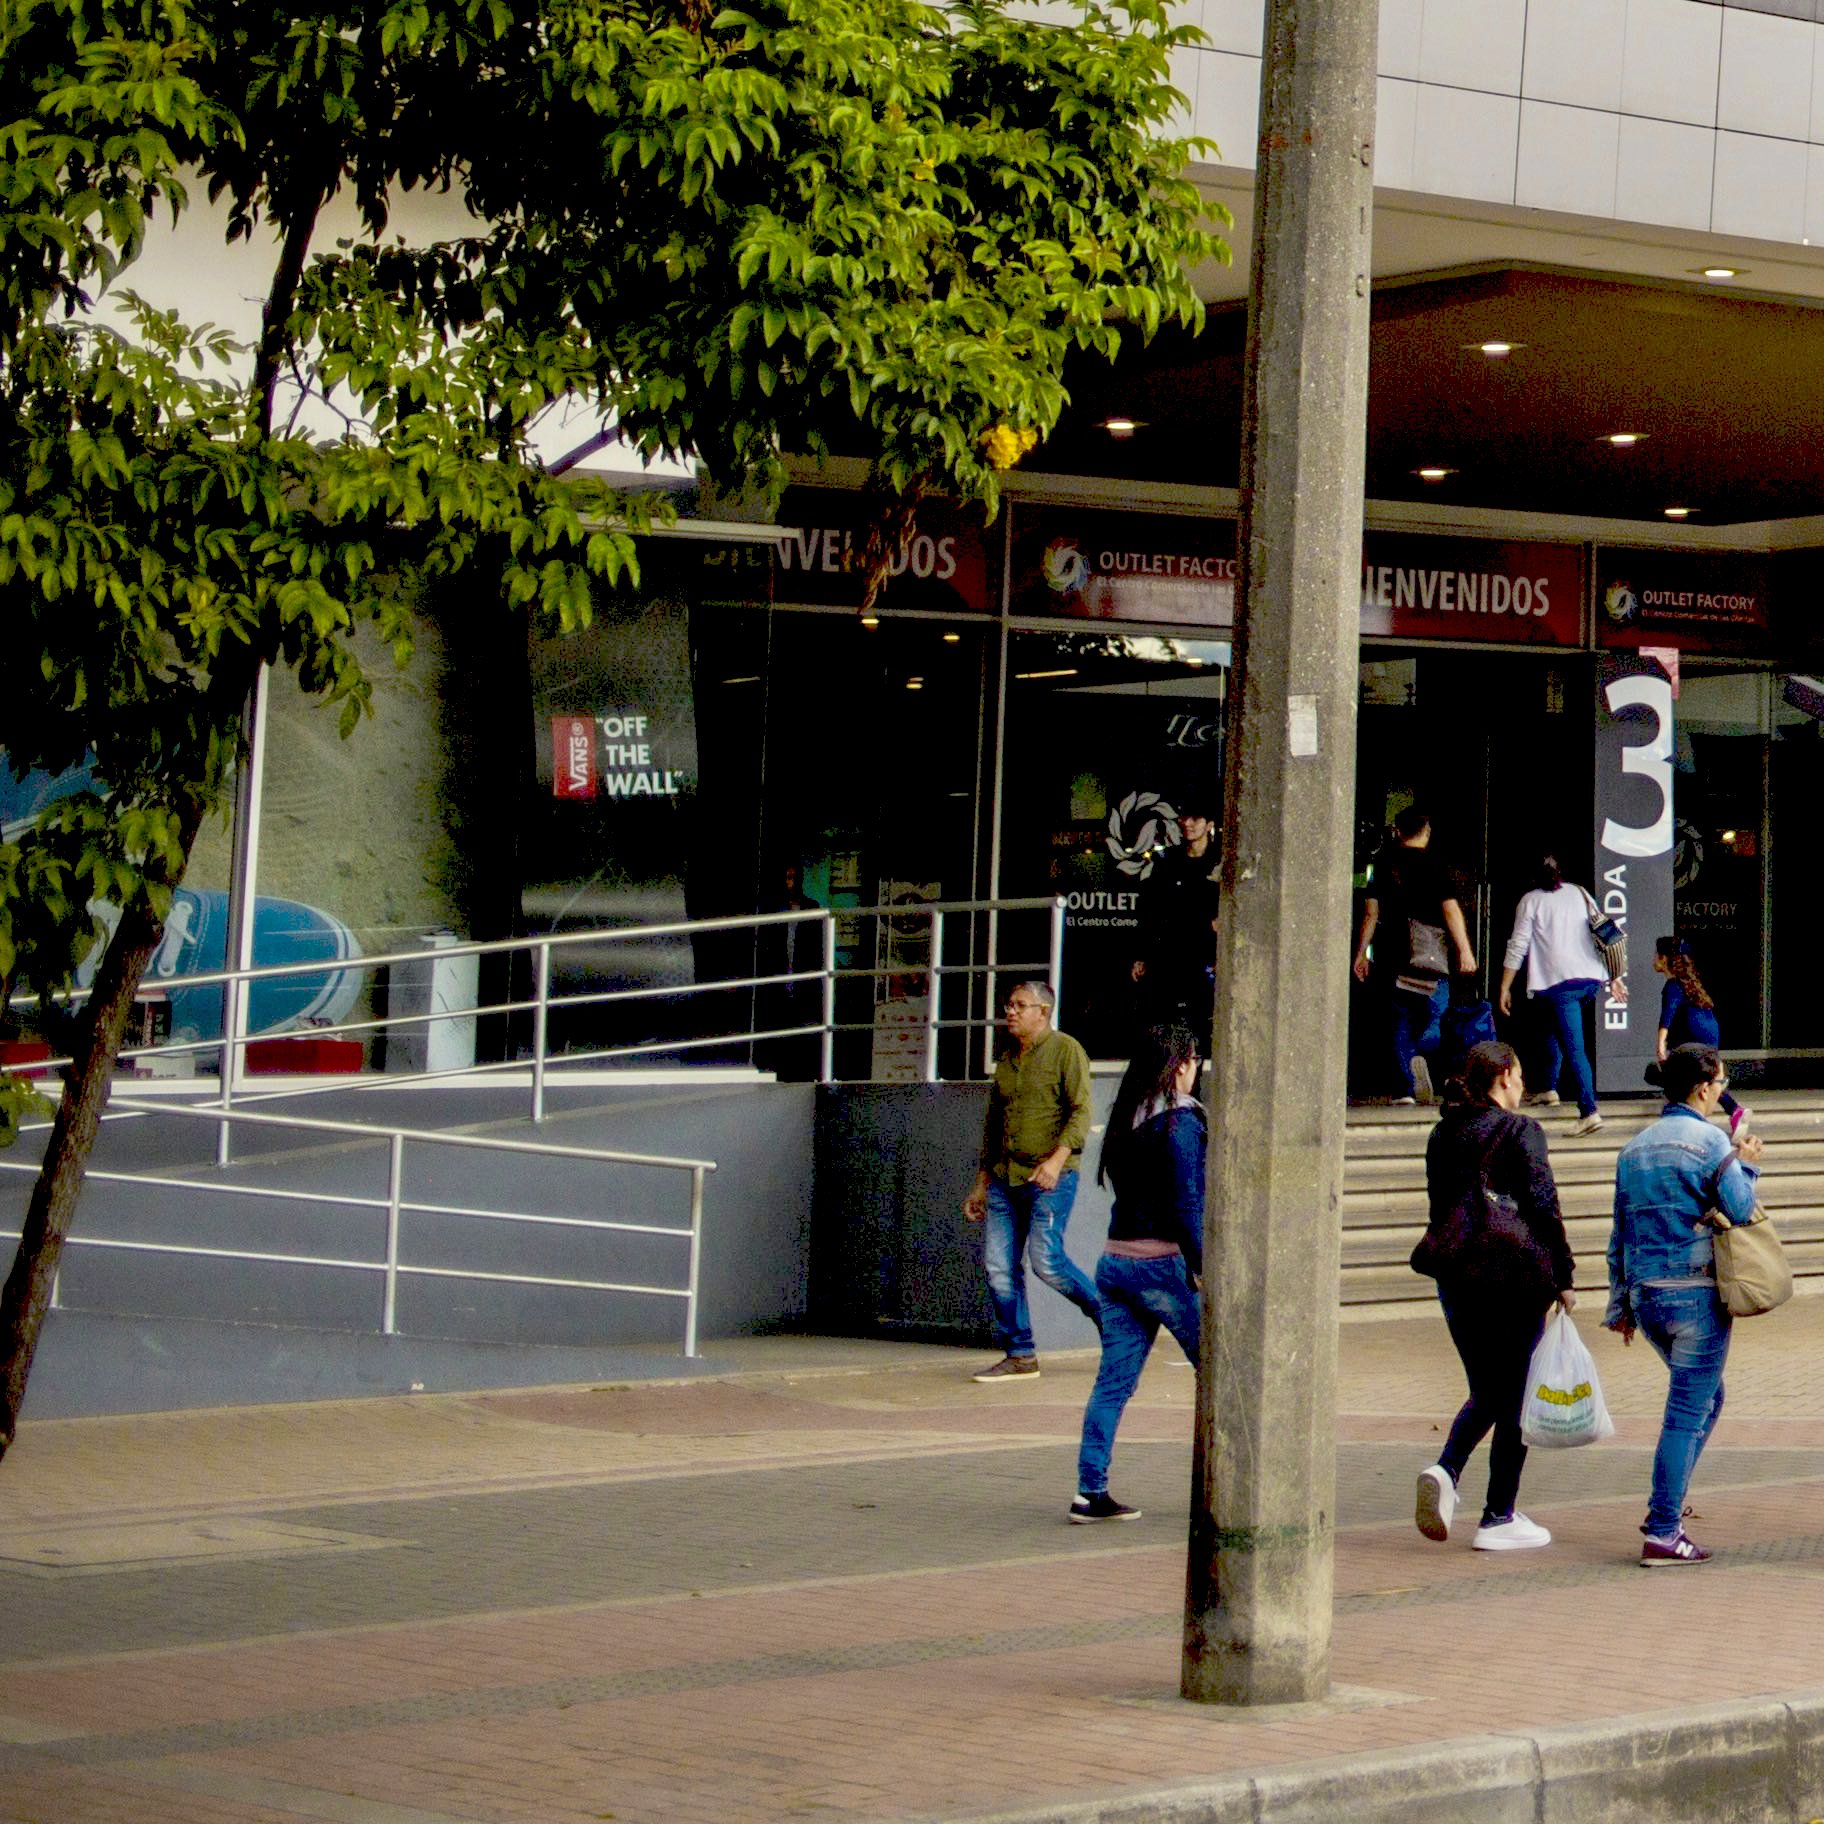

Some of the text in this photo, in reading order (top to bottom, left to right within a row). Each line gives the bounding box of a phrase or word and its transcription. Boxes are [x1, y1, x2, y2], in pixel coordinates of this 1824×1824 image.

[1100, 551, 1175, 576] OUTLET
[1363, 565, 1550, 617] IENVENIDOS
[1643, 589, 1755, 611] OUTLET FACTORY
[606, 744, 650, 766] THE
[1601, 675, 1674, 857] 3
[1067, 891, 1140, 911] OUTLET
[1676, 902, 1738, 917] FACTORY
[1077, 916, 1109, 927] Centro
